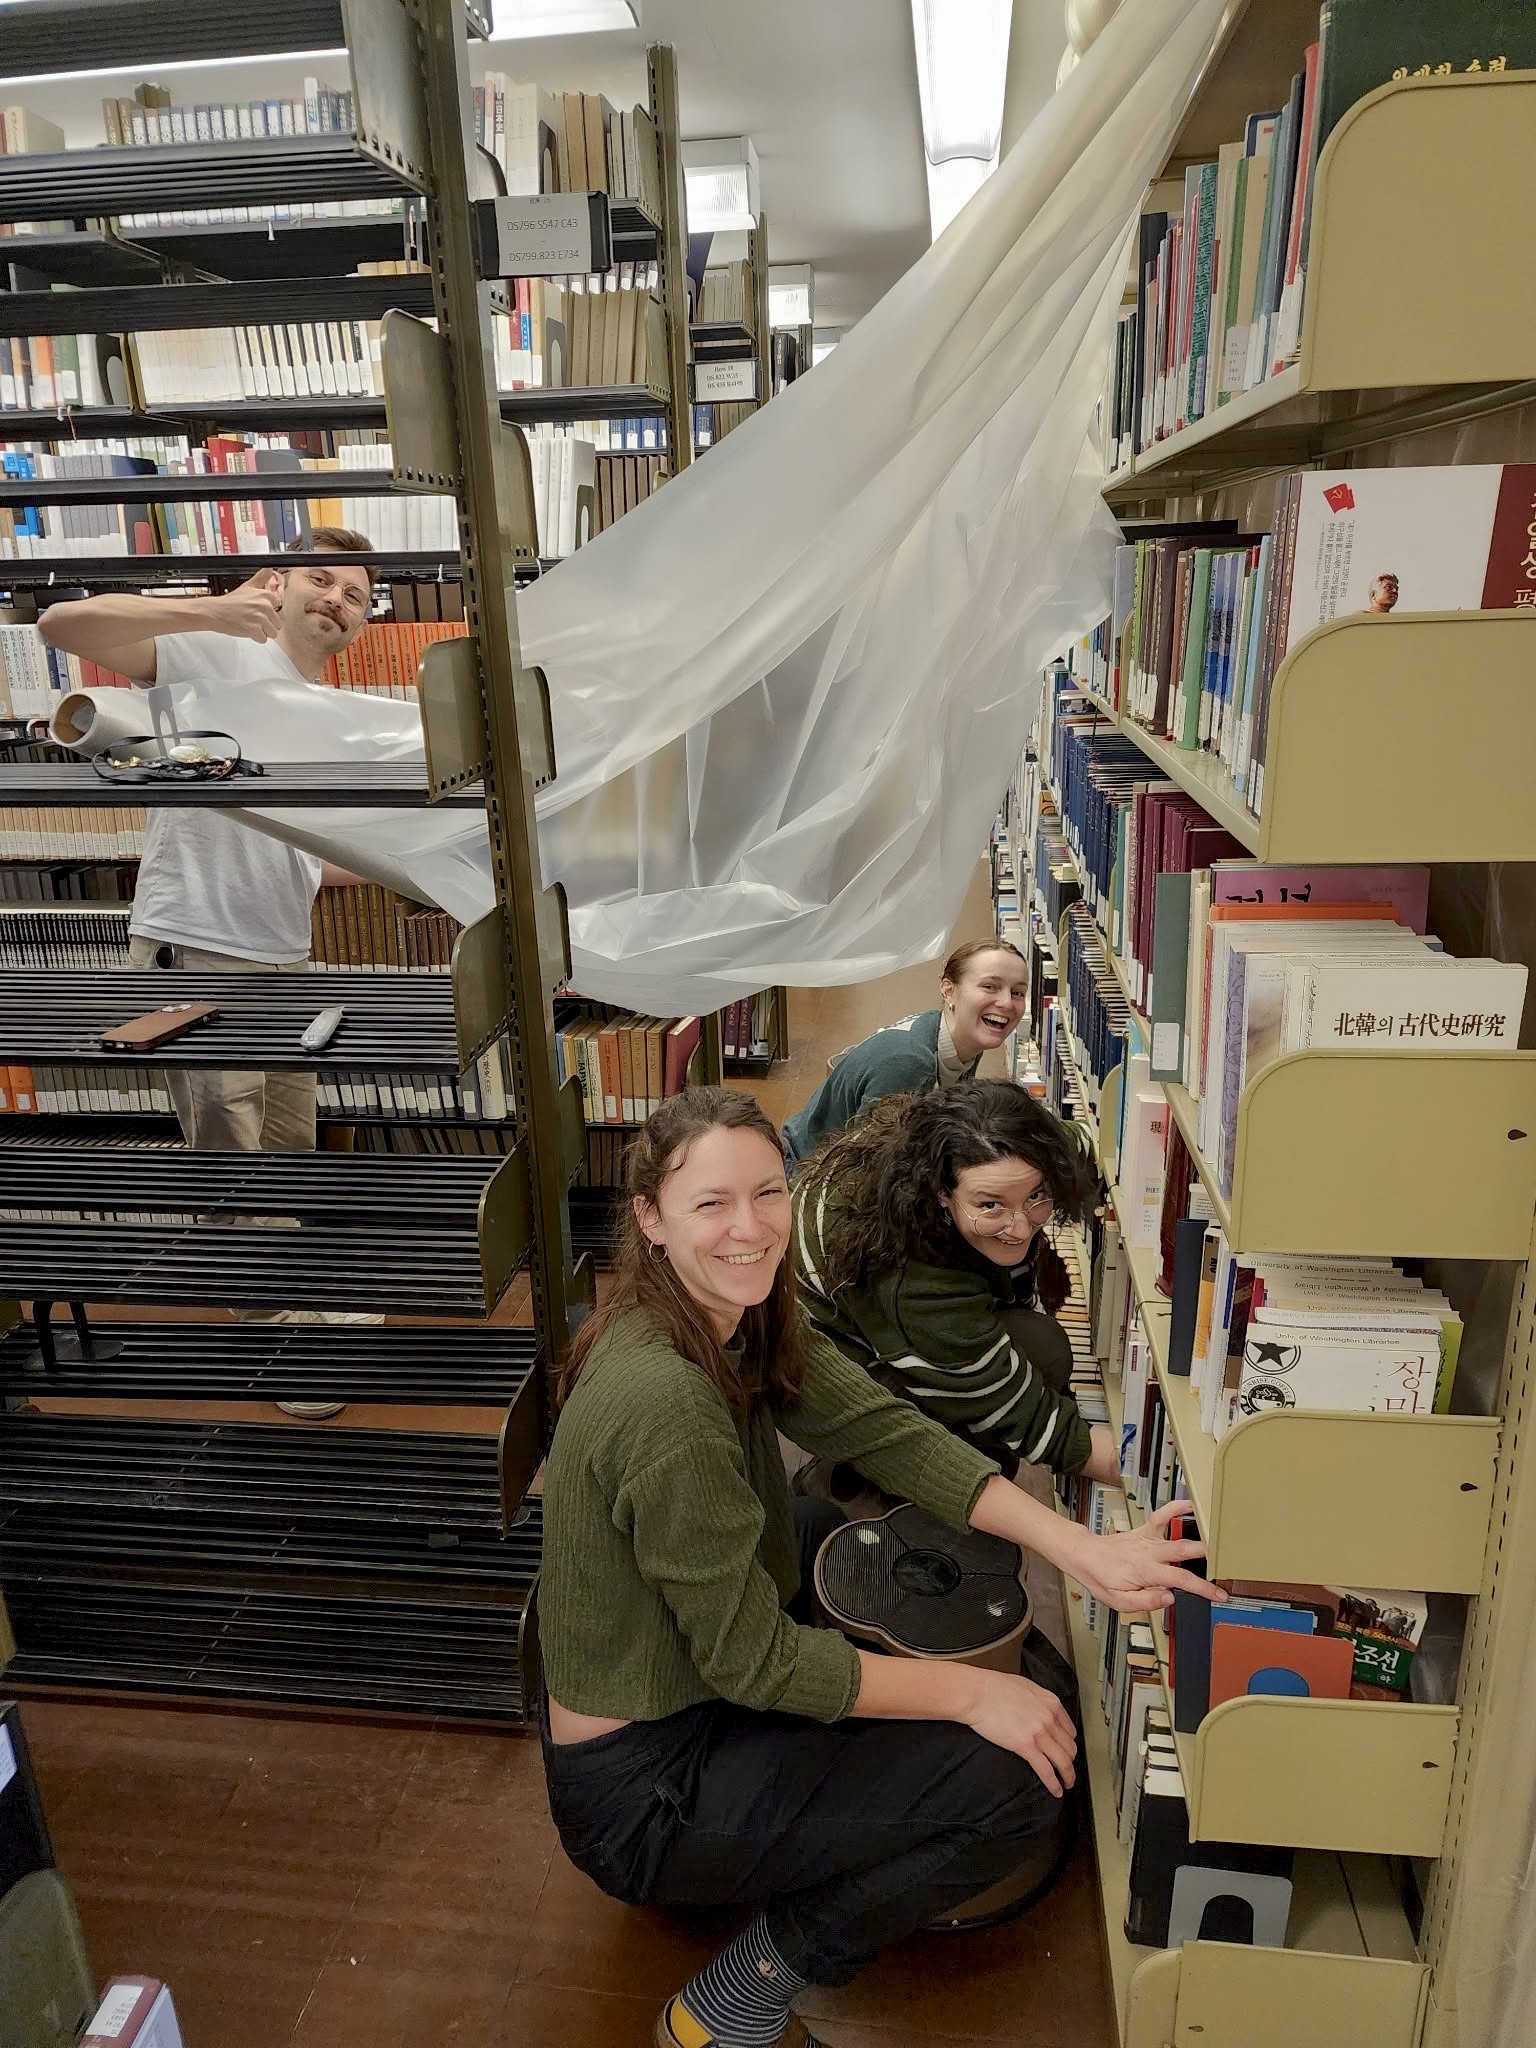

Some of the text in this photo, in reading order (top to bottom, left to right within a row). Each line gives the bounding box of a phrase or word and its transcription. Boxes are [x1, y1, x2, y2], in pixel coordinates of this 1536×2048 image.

[507, 218, 578, 231] DS796 S547 C43
[509, 251, 556, 262] DS799.823
[1333, 1012, 1394, 1037] 北韓의
[1250, 1260, 1291, 1270] University
[1306, 1265, 1354, 1274] Washington
[1338, 1293, 1381, 1302] Washington
[1275, 1332, 1295, 1340] Univ.
[1309, 1335, 1360, 1344] Washington
[1242, 1377, 1293, 1400] SUNRISE COFFEE
[1352, 1637, 1400, 1675] 조선
